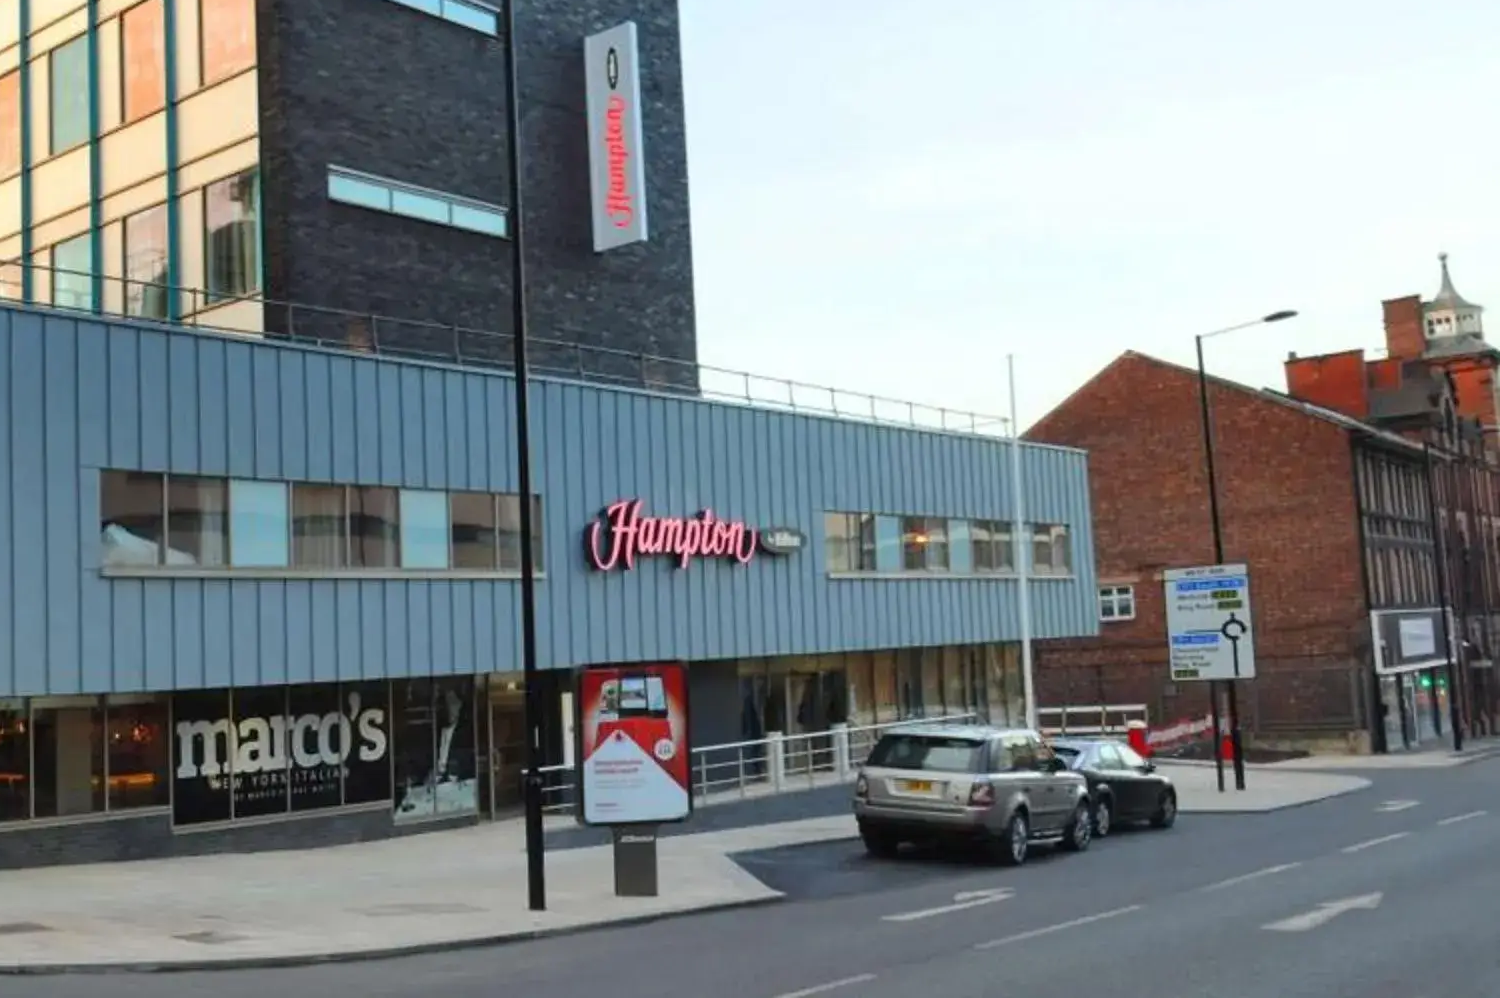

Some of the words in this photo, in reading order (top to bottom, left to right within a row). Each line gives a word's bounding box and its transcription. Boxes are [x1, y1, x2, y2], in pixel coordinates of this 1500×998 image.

[605, 95, 634, 229] Hampton
[591, 499, 756, 571] Hampton
[177, 692, 387, 779] marco's
